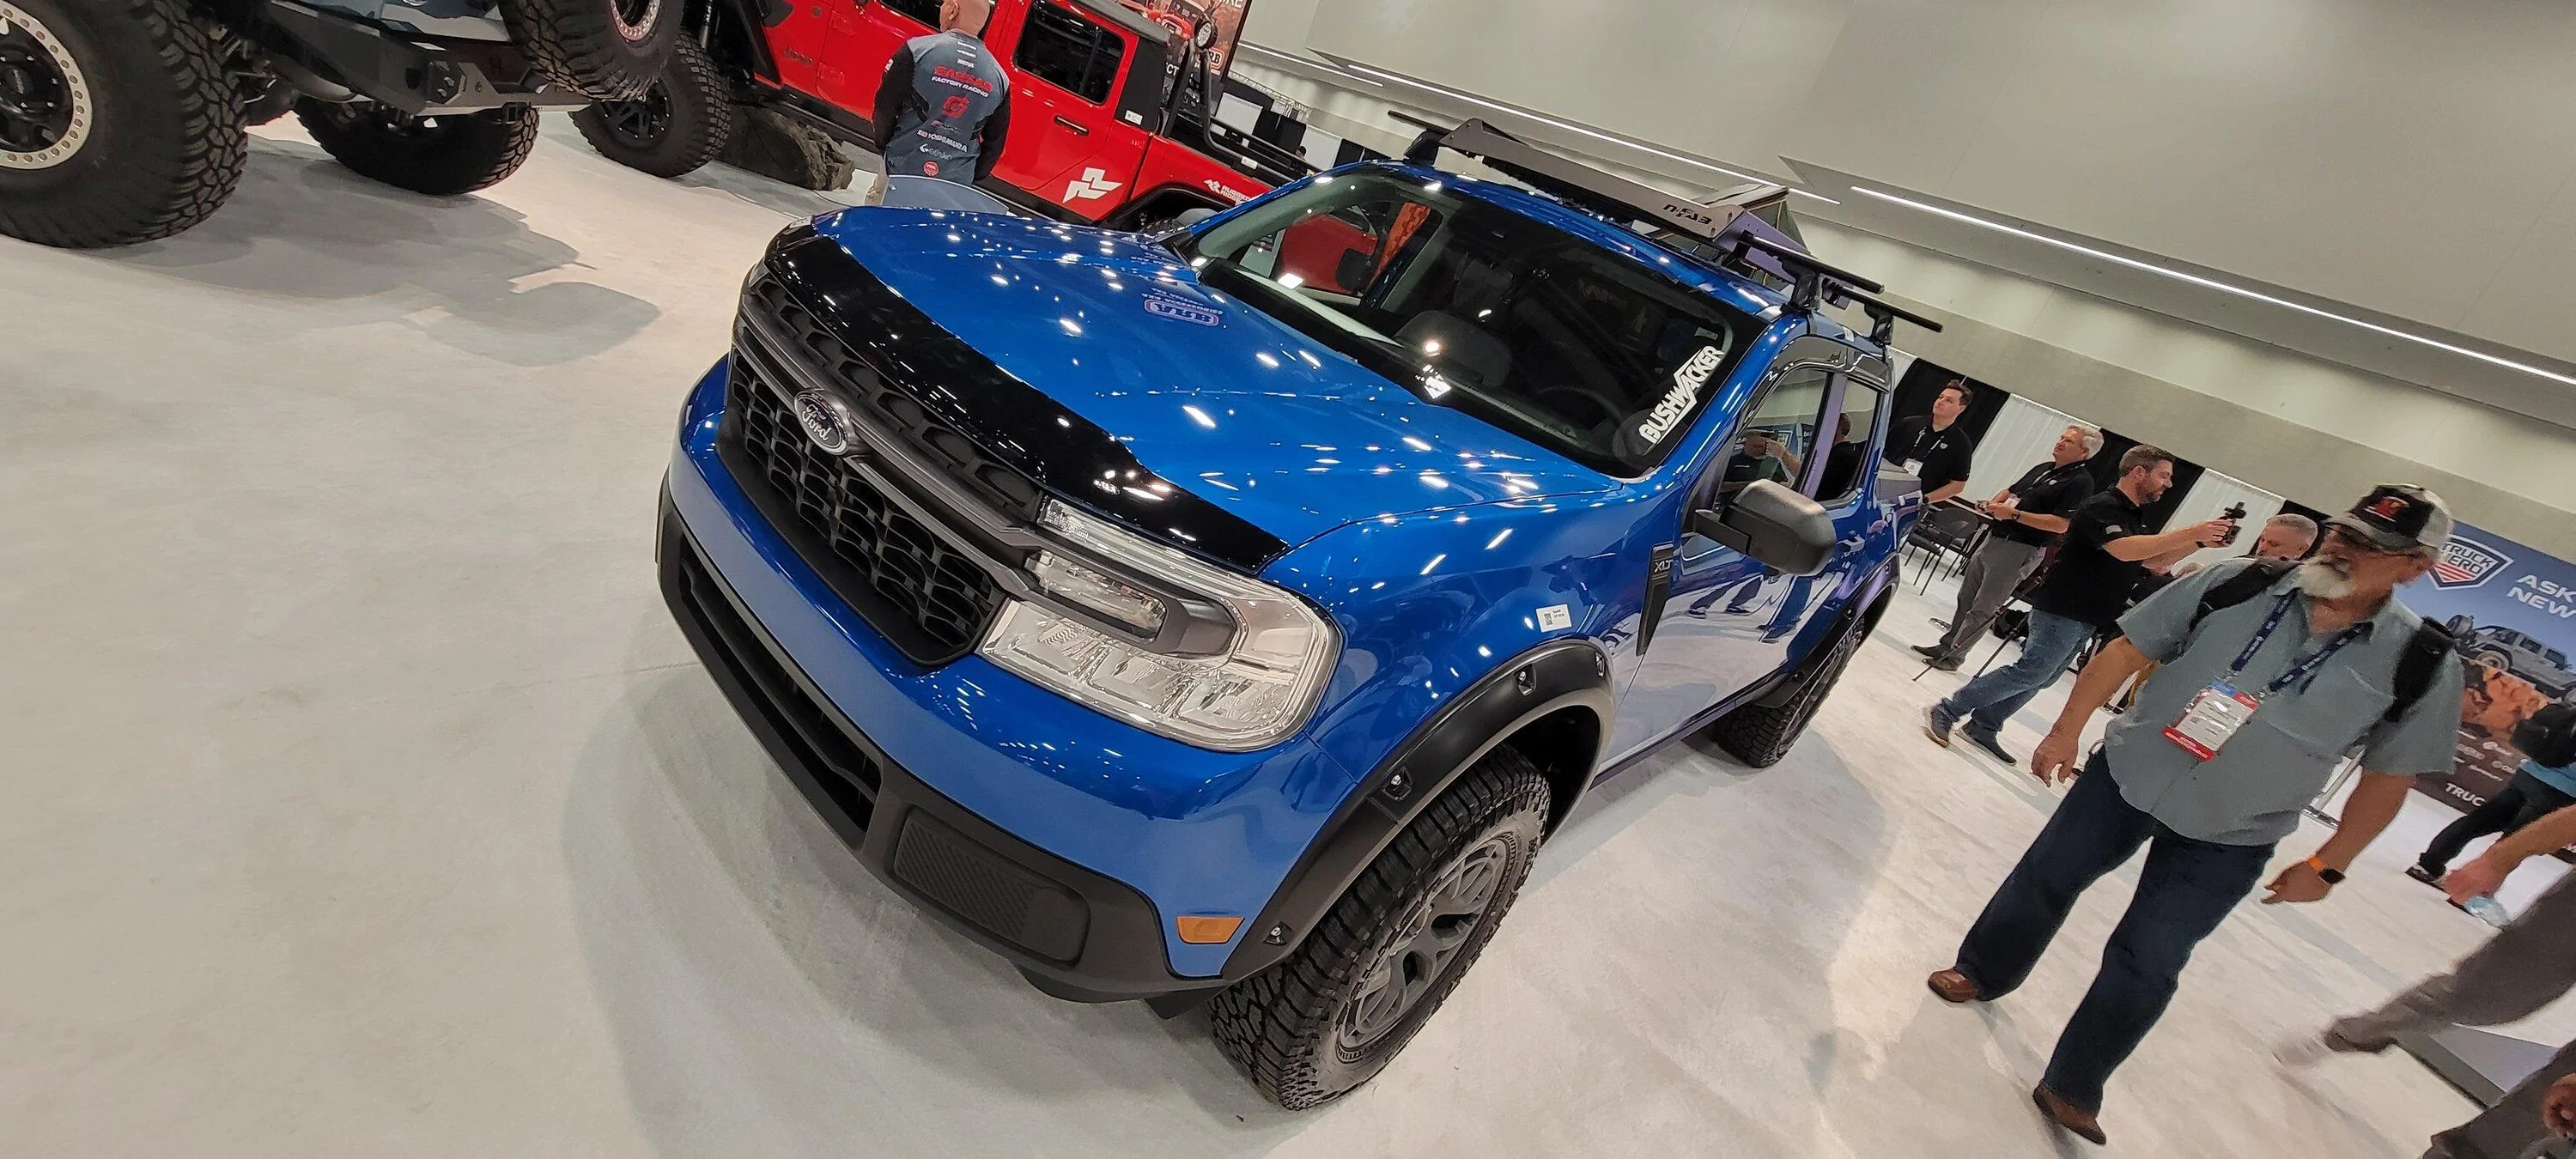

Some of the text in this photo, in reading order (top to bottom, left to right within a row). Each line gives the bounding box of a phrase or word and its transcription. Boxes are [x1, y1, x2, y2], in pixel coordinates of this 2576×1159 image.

[931, 76, 989, 98] FACTORY RACING
[1638, 345, 1726, 445] BUSHWACKER
[802, 404, 832, 441] Ford
[1654, 559, 1674, 573] XLT
[2446, 554, 2483, 575] ERO
[2516, 573, 2576, 603] ASK
[2506, 586, 2576, 619] NEW
[2445, 782, 2487, 807] TRUC
